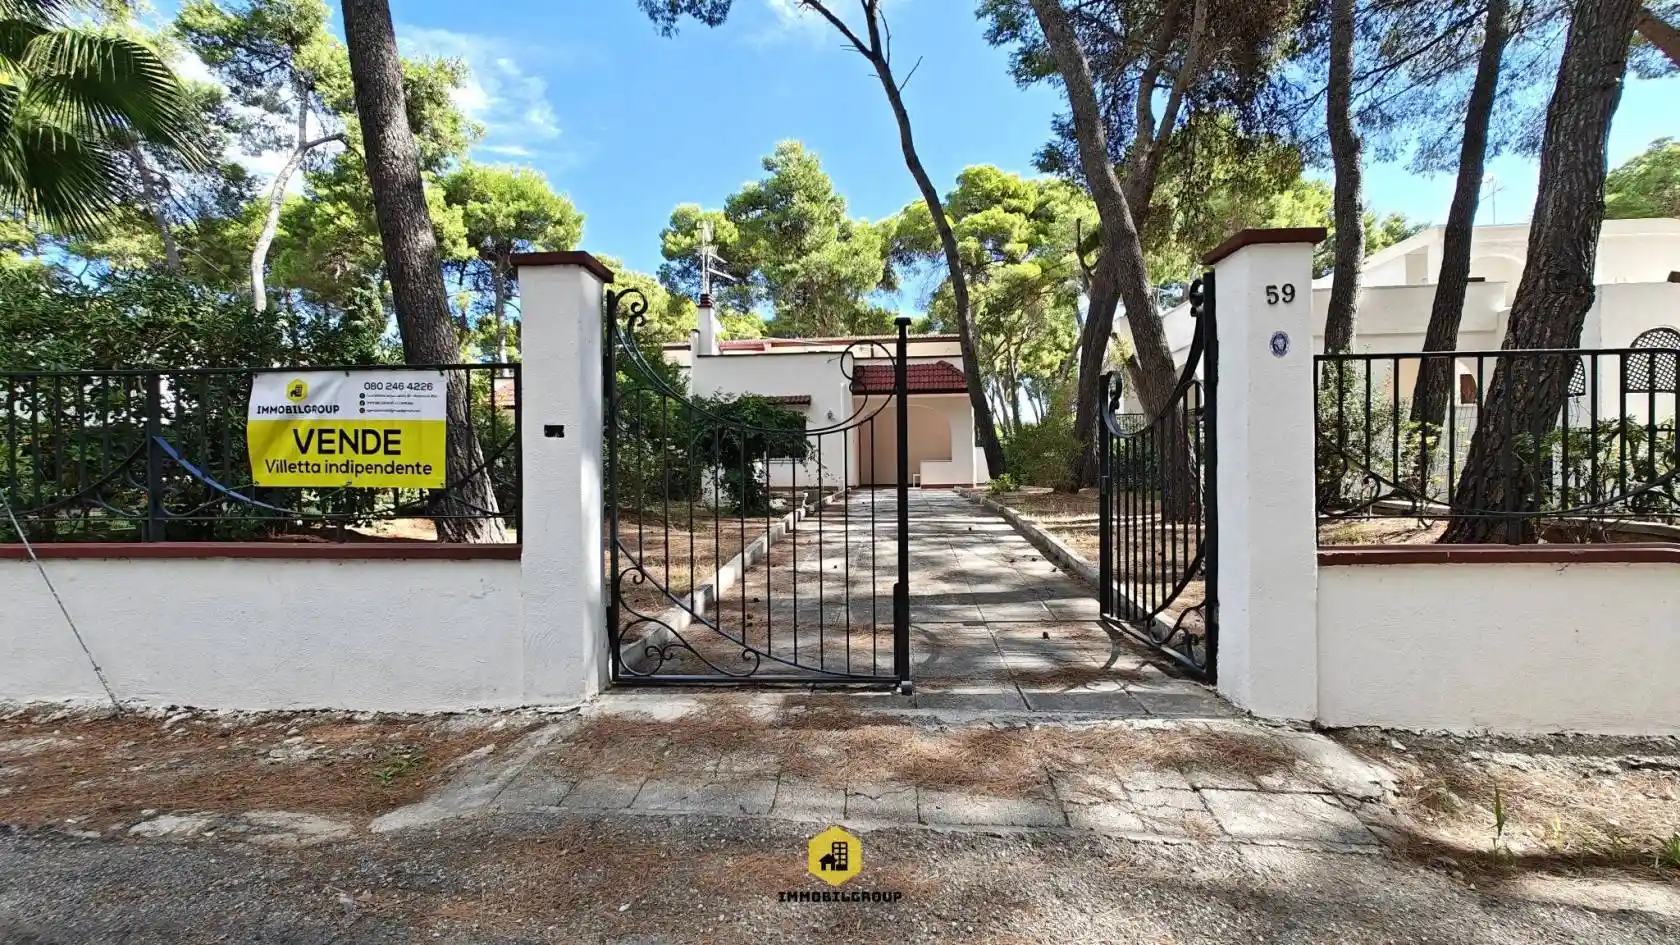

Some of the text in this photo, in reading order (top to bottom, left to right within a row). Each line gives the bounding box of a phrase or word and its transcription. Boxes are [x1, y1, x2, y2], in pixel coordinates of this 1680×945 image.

[1265, 283, 1296, 305] 59
[364, 382, 433, 391] 080 246 4226
[256, 404, 340, 414] IMMOBILGROUP
[292, 428, 402, 455] VENDE
[265, 459, 433, 477] Villetta indipendente
